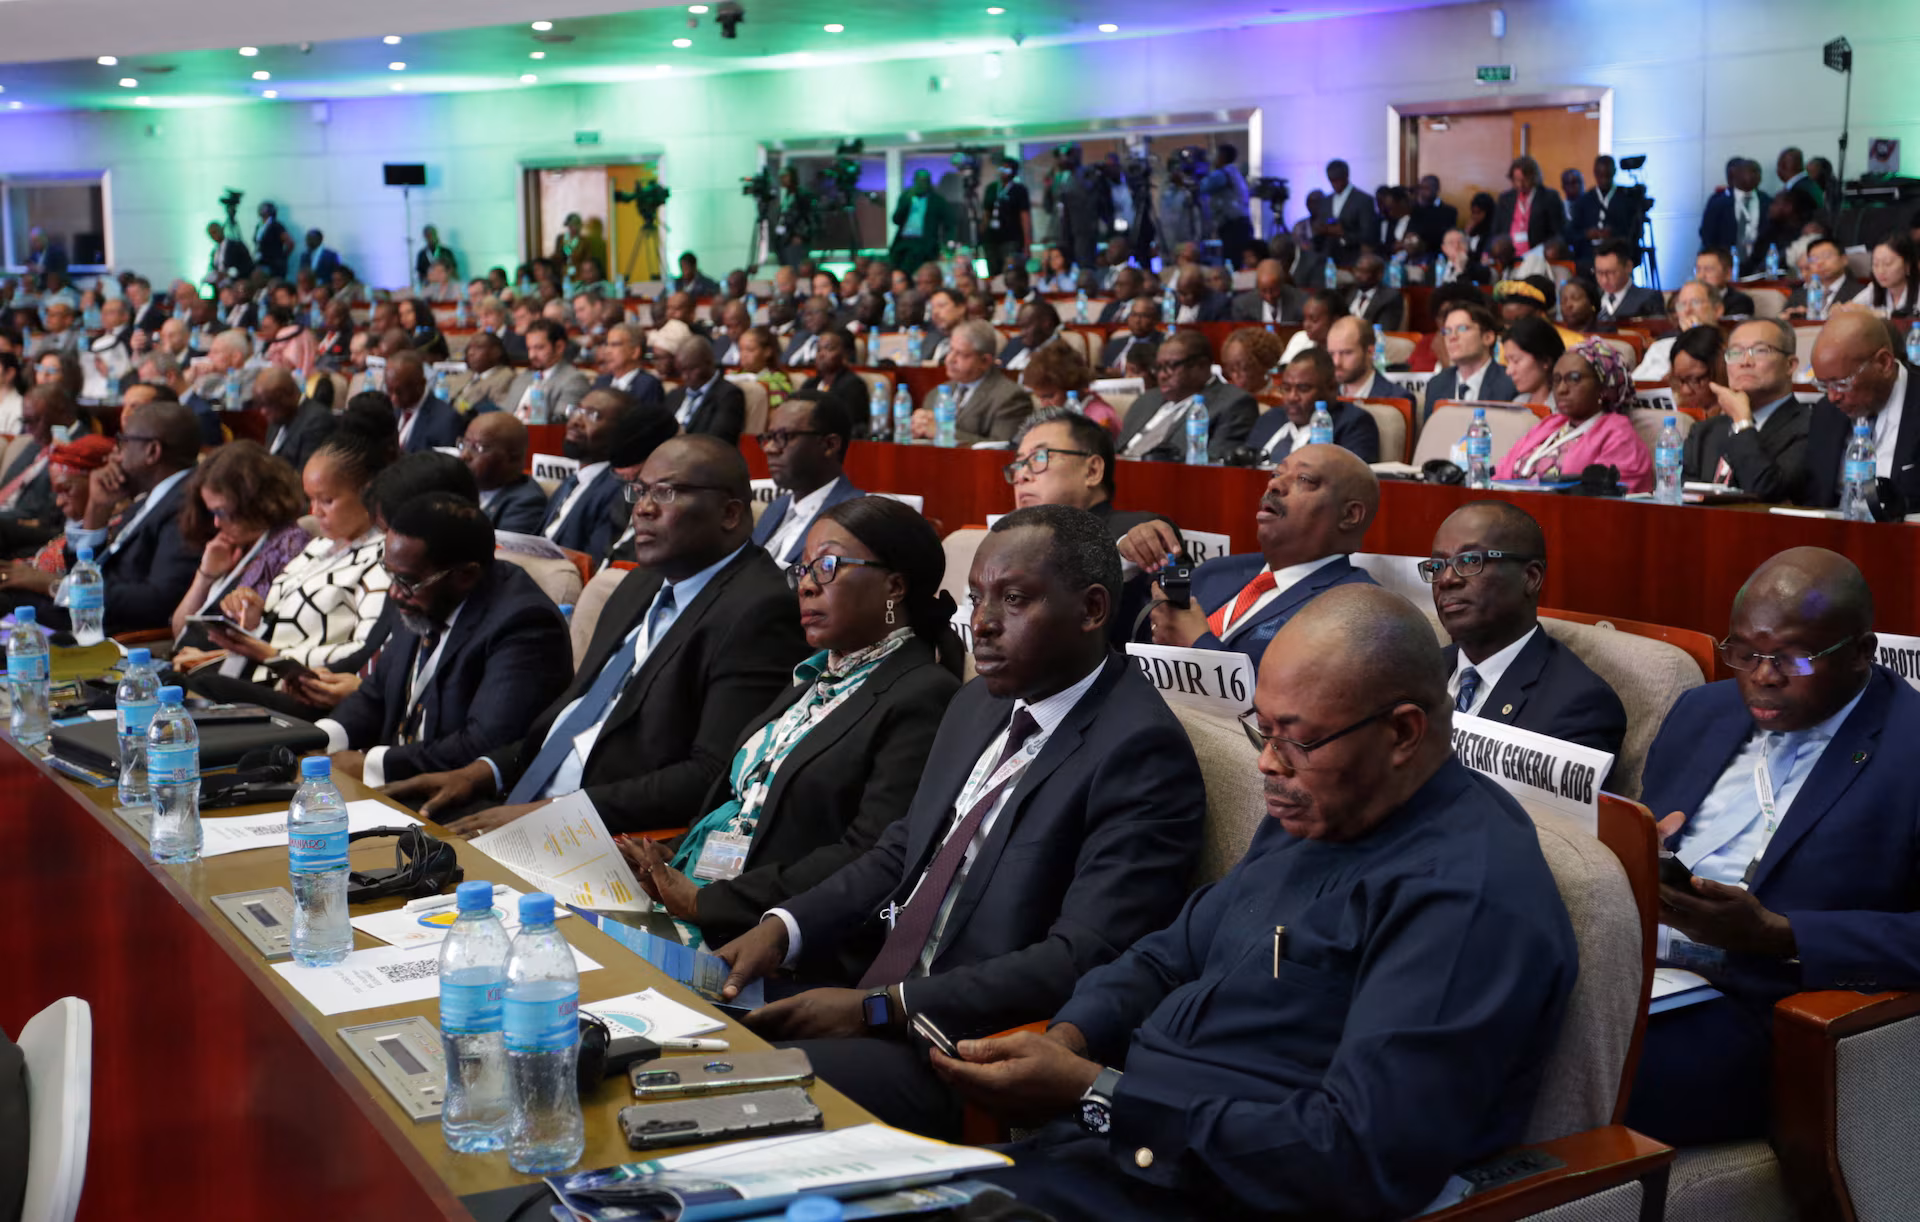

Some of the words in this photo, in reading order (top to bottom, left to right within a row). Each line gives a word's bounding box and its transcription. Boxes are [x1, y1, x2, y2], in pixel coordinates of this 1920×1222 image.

[1138, 656, 1210, 697] BDIR
[1213, 664, 1247, 702] 16
[1501, 742, 1558, 798] GENERAL,
[1560, 760, 1596, 805] AfDB
